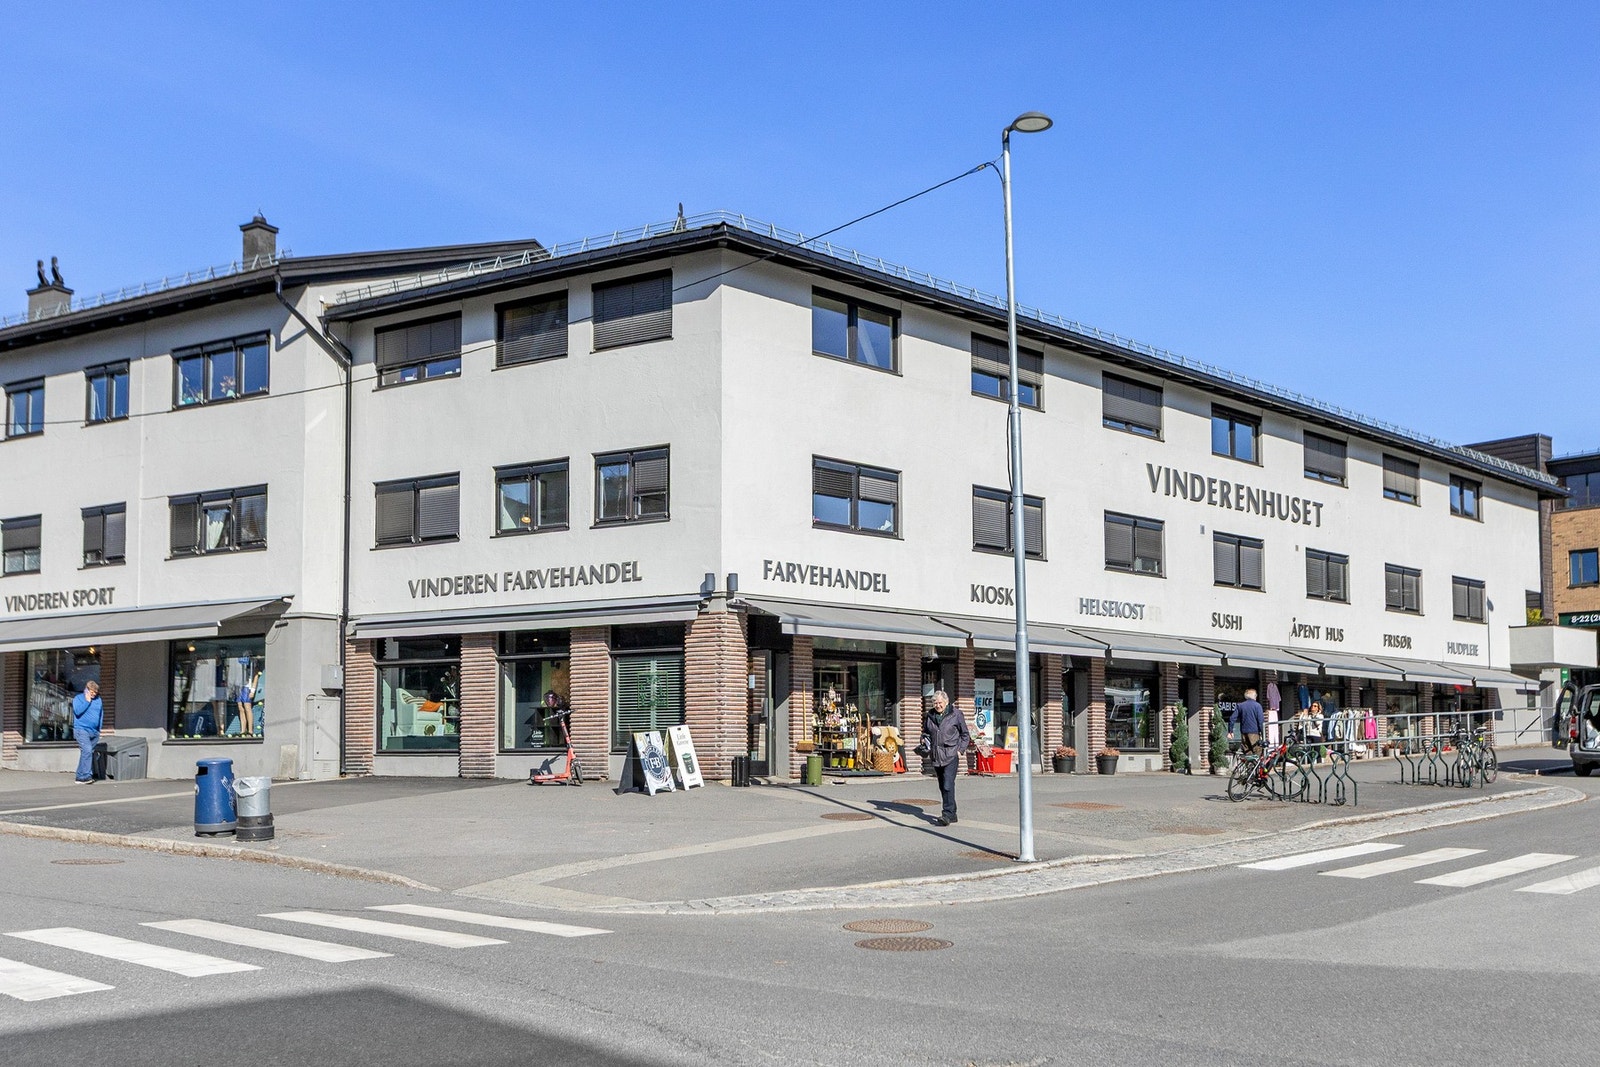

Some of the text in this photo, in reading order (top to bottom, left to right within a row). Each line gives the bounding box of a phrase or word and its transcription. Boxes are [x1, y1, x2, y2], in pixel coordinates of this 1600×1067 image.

[1146, 462, 1324, 528] VINDERENHUSET
[408, 560, 643, 599] VINDEREN FARVEHANDEL
[763, 559, 891, 593] FARVEHANDEL
[5, 586, 116, 613] VINDEREN SPORT
[970, 583, 1014, 606] KIOSK
[1079, 597, 1146, 620] HELSEKOST
[1590, 613, 1600, 623] (2
[1211, 611, 1243, 631] SUSHI
[1291, 617, 1344, 643] ÅPENT HUS
[1383, 633, 1412, 650] FRISØR
[1447, 641, 1479, 657] HUDPLEIE
[982, 697, 993, 707] ICE
